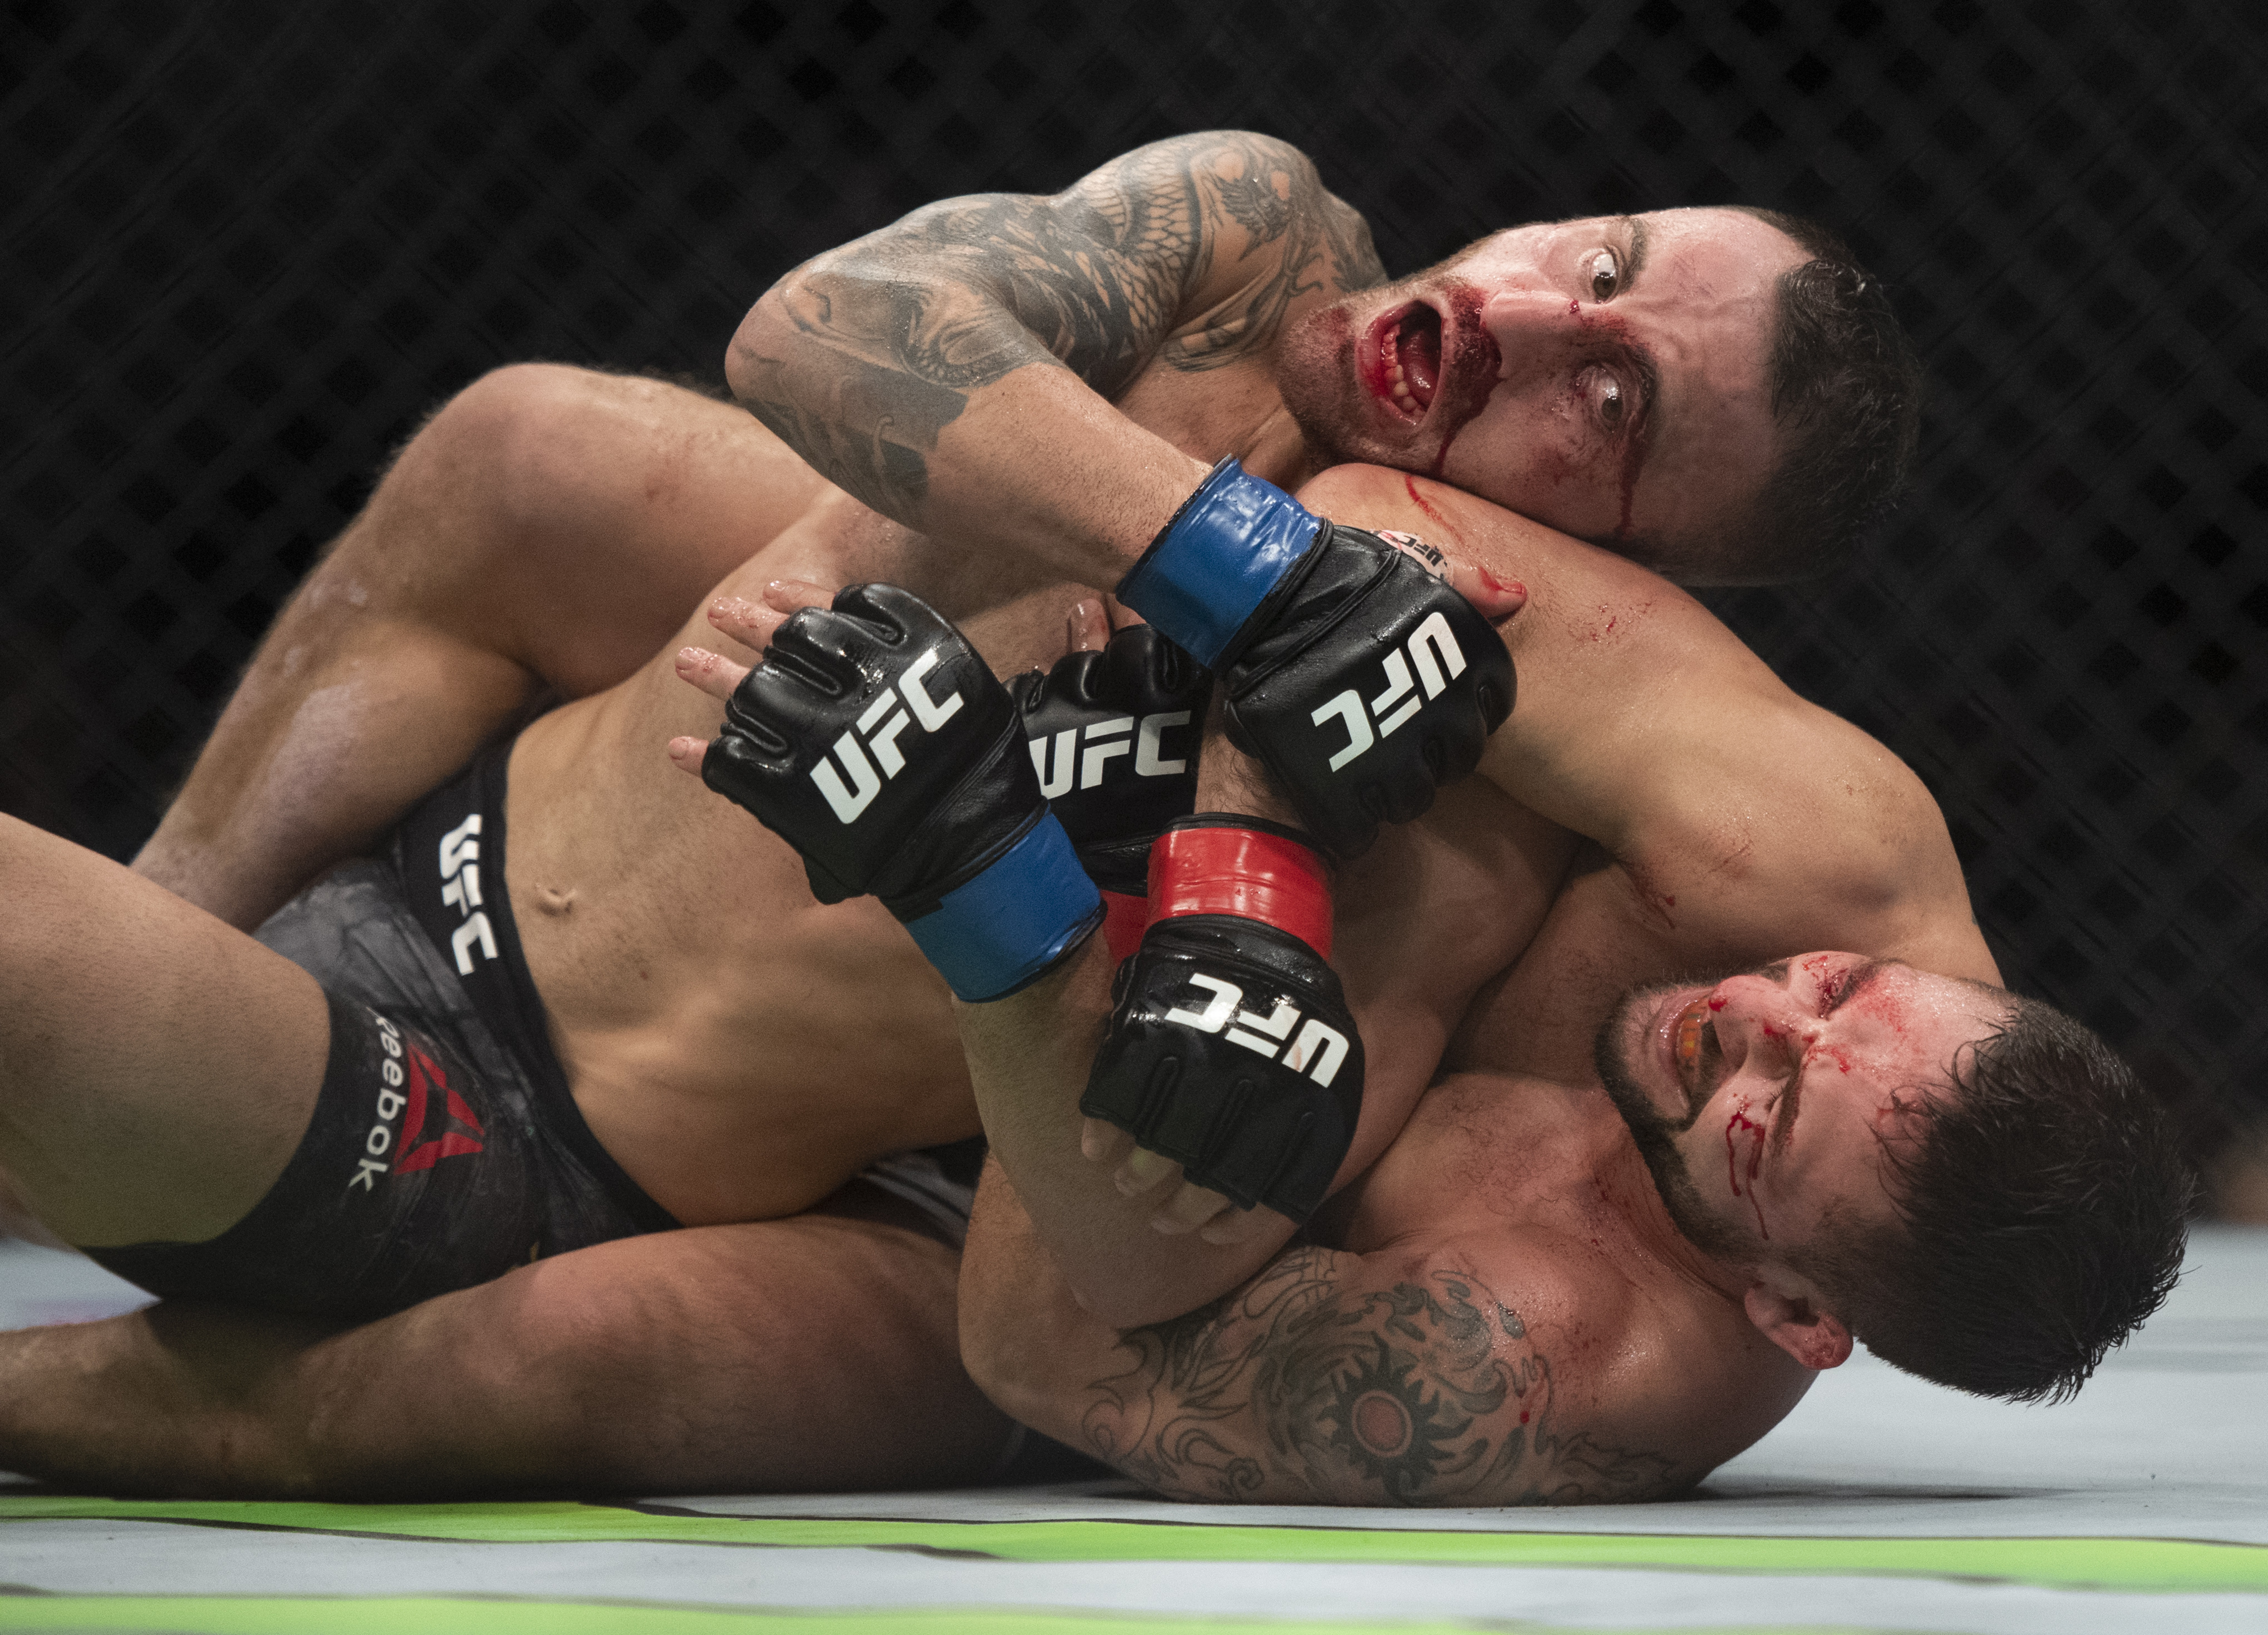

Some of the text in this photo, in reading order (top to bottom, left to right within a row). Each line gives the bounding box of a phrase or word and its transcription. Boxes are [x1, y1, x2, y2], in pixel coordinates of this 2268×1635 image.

[1398, 535, 1443, 567] UFC
[810, 649, 964, 824] UFC
[1029, 710, 1190, 800] UFC
[1311, 612, 1466, 772] UFC
[440, 813, 498, 975] UFC
[1165, 973, 1348, 1088] UFC
